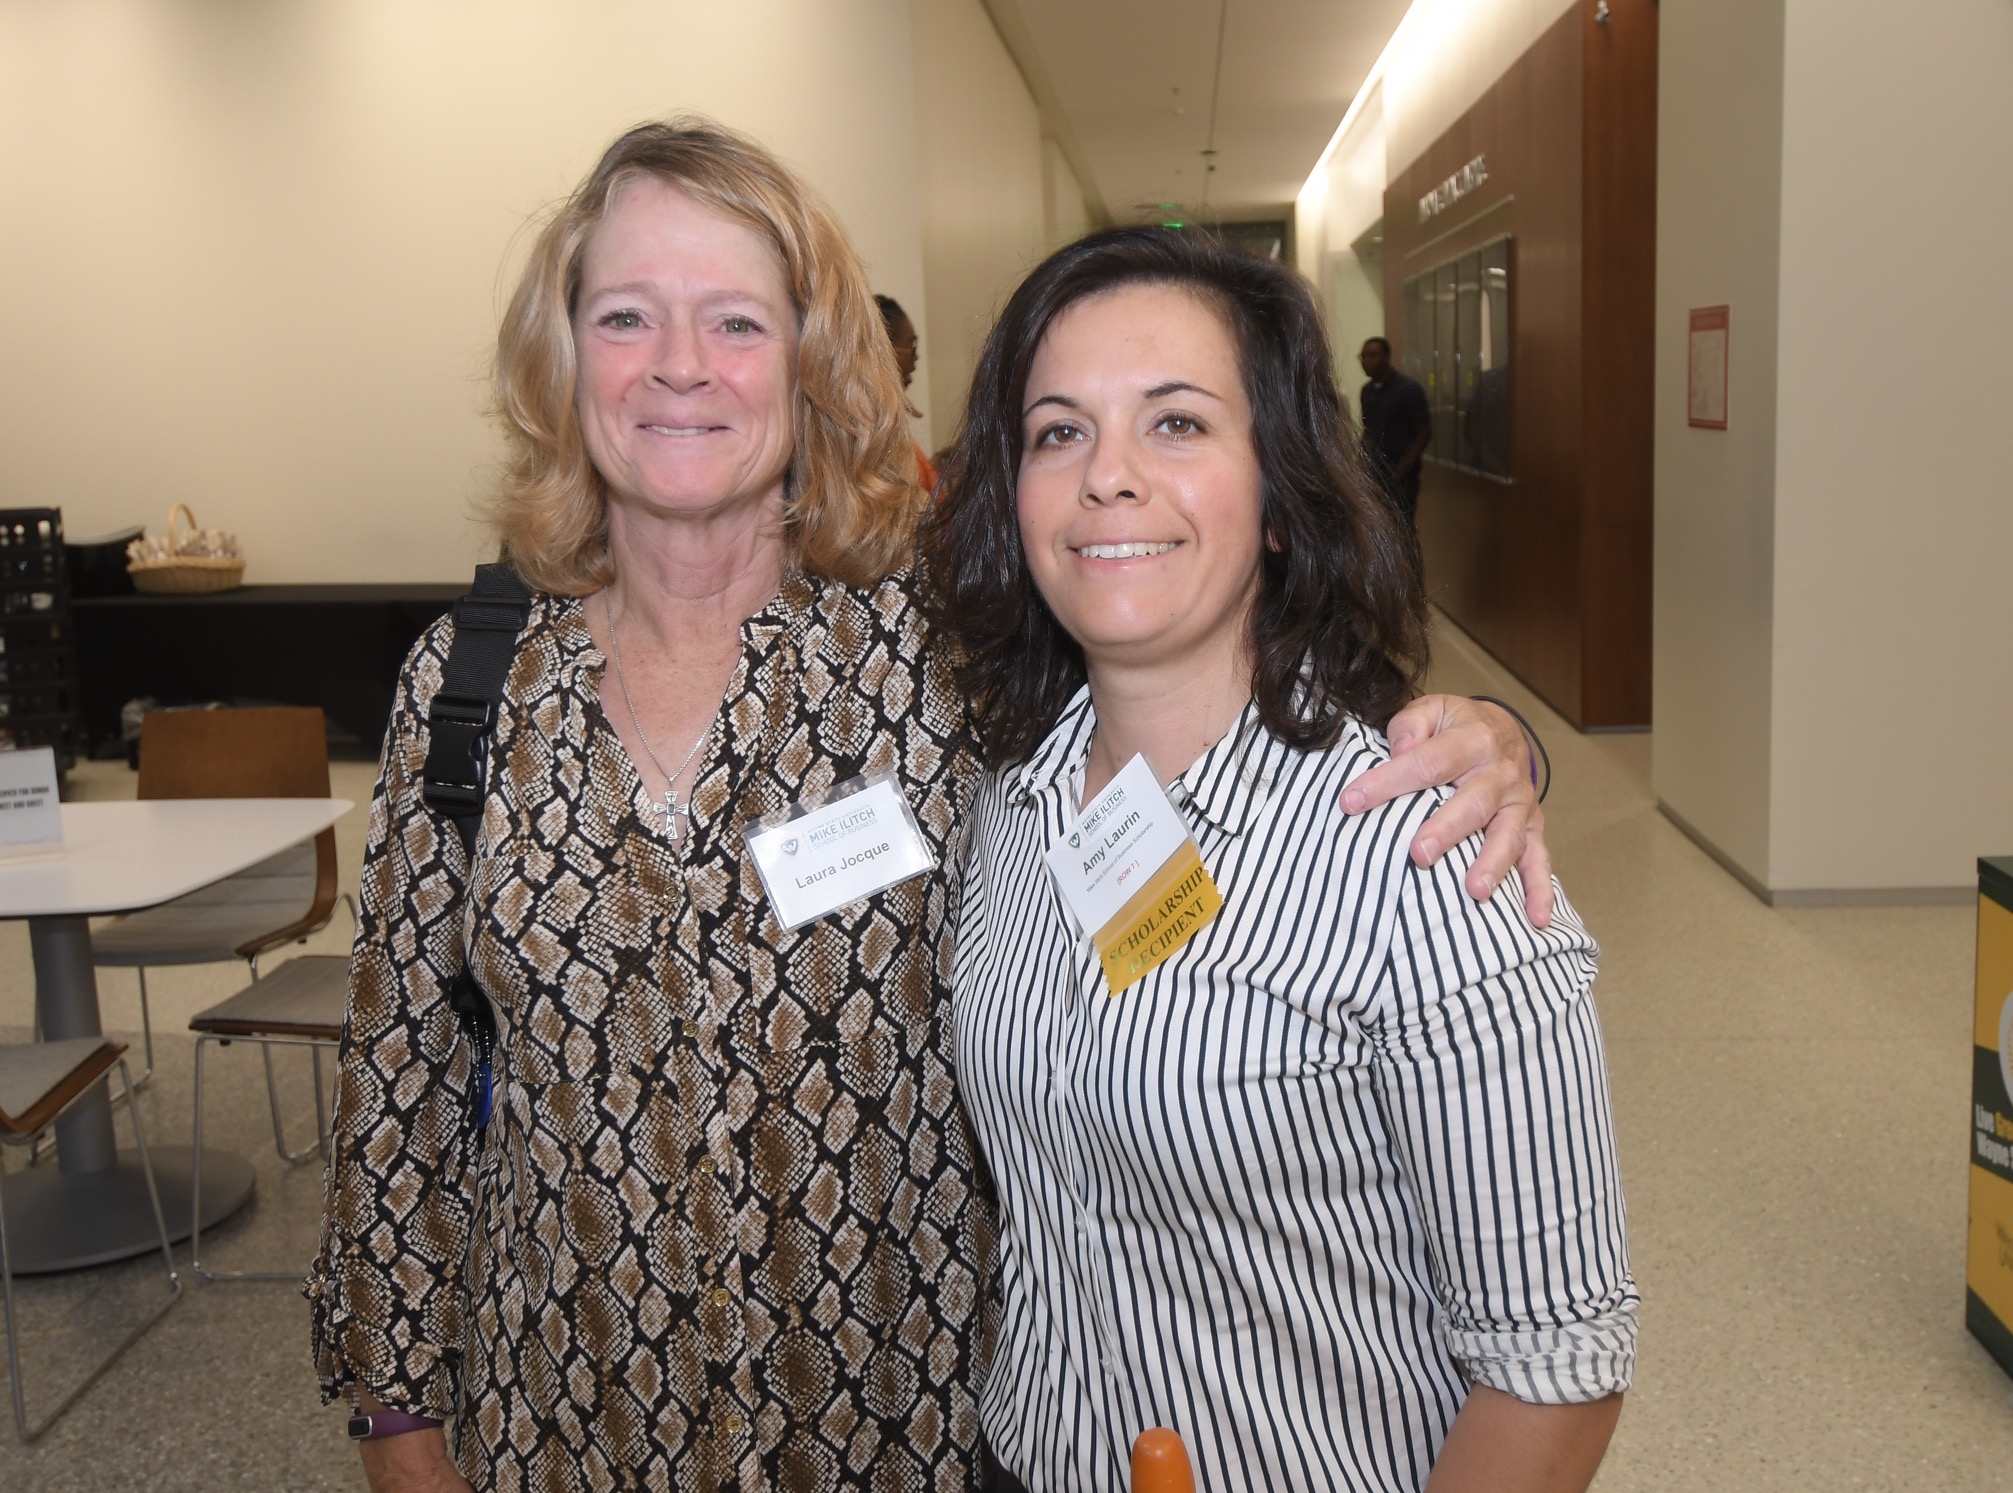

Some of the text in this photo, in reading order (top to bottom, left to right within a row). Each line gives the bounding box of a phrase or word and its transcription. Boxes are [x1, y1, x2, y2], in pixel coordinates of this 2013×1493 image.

[809, 808, 876, 843] MIKE ILITCH
[826, 816, 840, 825] STATE
[1083, 787, 1125, 833] MIKE ILITCH
[1088, 821, 1103, 837] SCHOOL
[1107, 796, 1128, 816] BUSINESS
[813, 817, 878, 849] SCHOOL OF BUSINESS
[1082, 810, 1141, 875] Amy Laurin
[1102, 864, 1115, 876] School
[1116, 842, 1134, 860] Business
[1133, 821, 1153, 843] Scholarship
[795, 841, 890, 889] Laura Jocque
[1109, 866, 1206, 974] SCHOLARSHIP RECIPIENT
[1976, 1103, 1995, 1133] Live
[1976, 1131, 2009, 1168] Wayne
